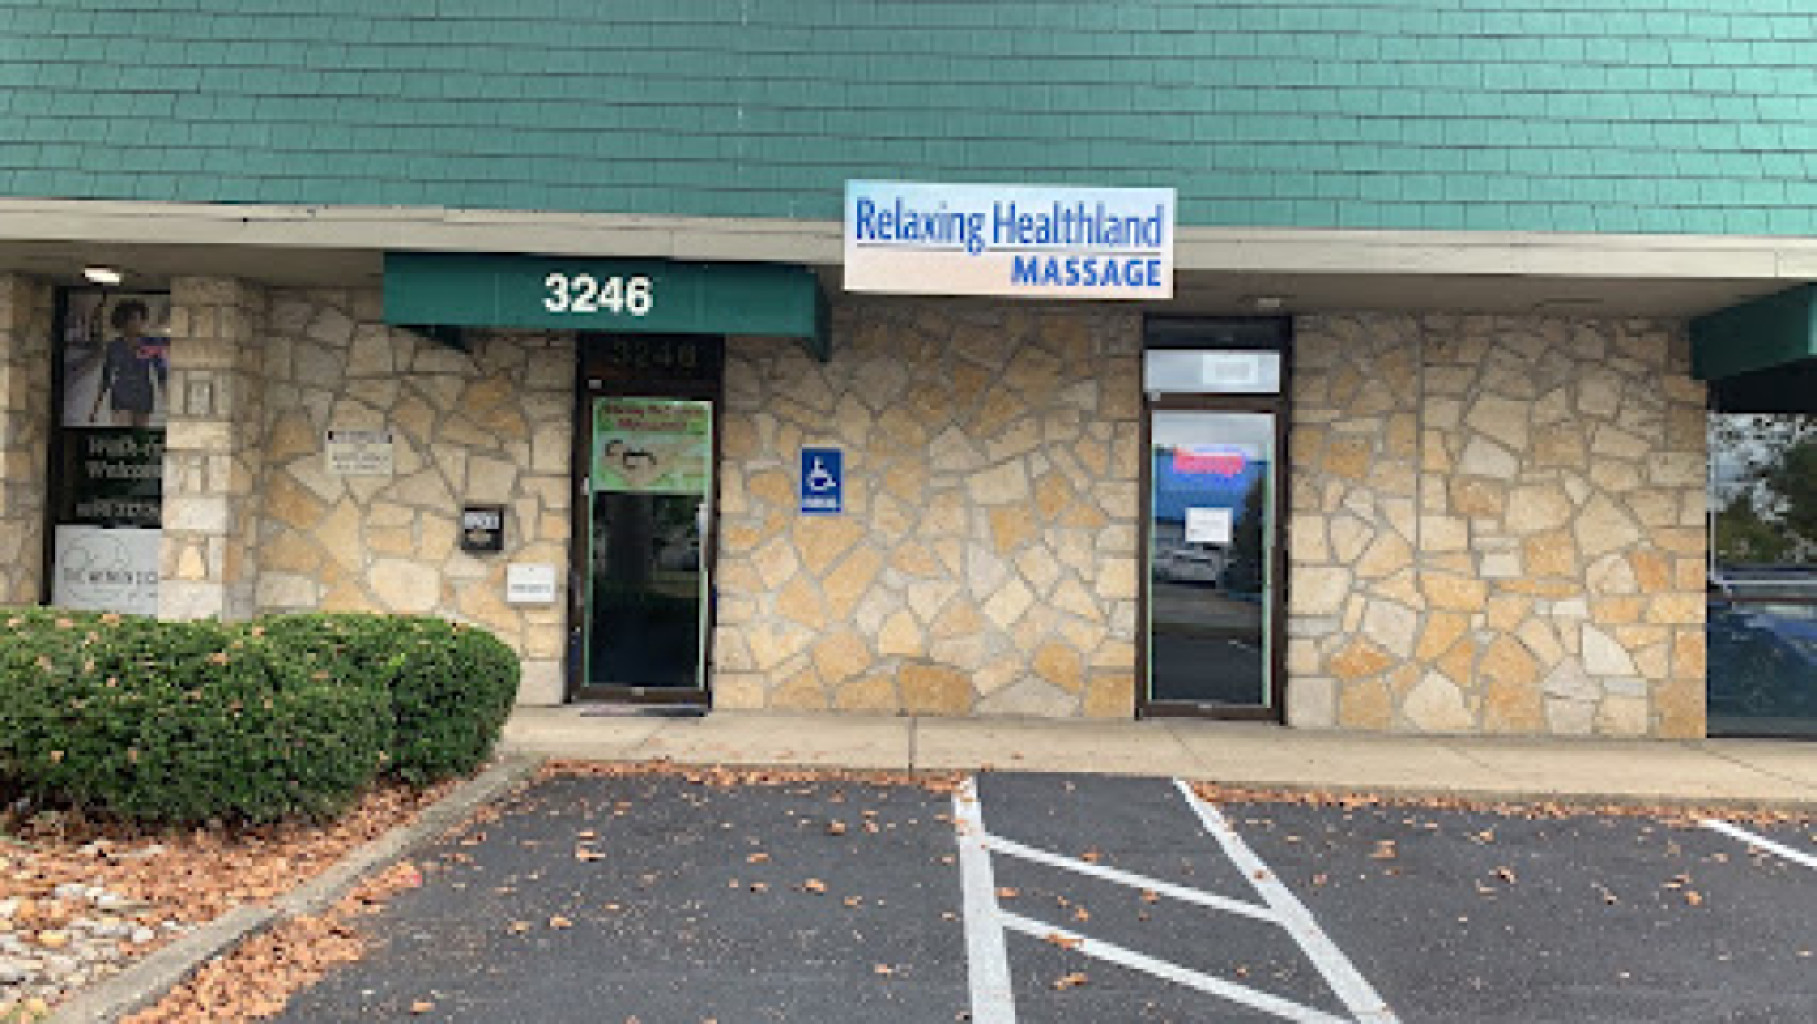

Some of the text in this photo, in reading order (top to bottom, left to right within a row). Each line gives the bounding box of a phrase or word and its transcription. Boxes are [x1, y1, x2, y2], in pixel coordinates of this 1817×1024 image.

[856, 196, 1165, 255] Relaxing Healthland
[1010, 255, 1162, 287] MASSAGE
[543, 272, 654, 316] 3246
